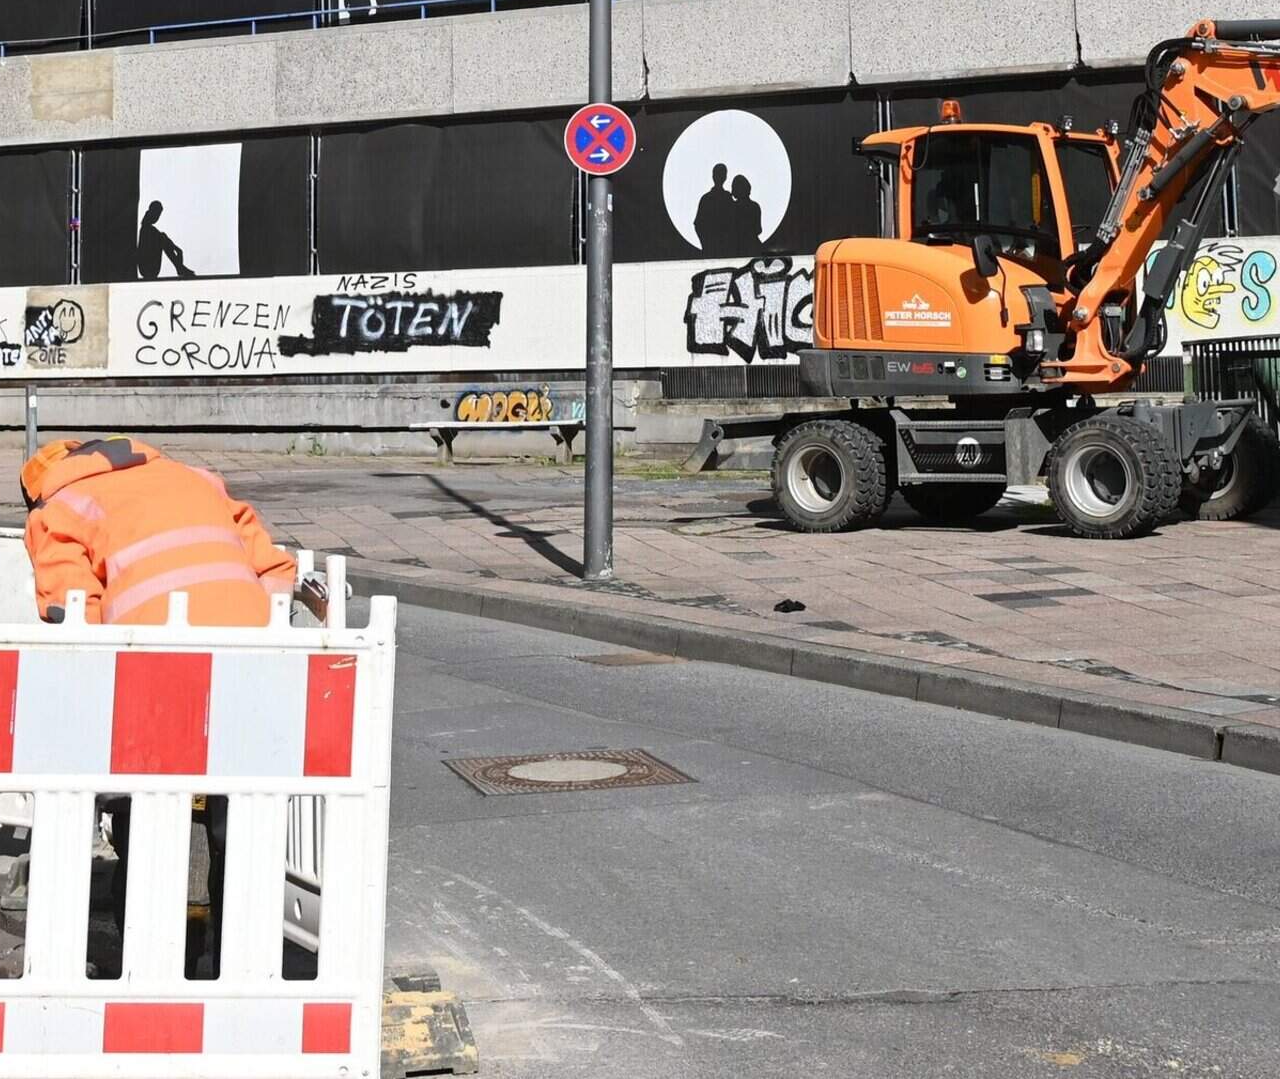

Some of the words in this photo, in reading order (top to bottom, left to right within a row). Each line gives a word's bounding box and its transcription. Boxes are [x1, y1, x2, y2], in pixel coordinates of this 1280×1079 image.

[336, 274, 418, 292] NAZIS
[136, 300, 291, 339] GRENZEN
[331, 297, 473, 339] TÖTEN
[885, 311, 913, 320] PETER
[136, 336, 277, 369] CORONA
